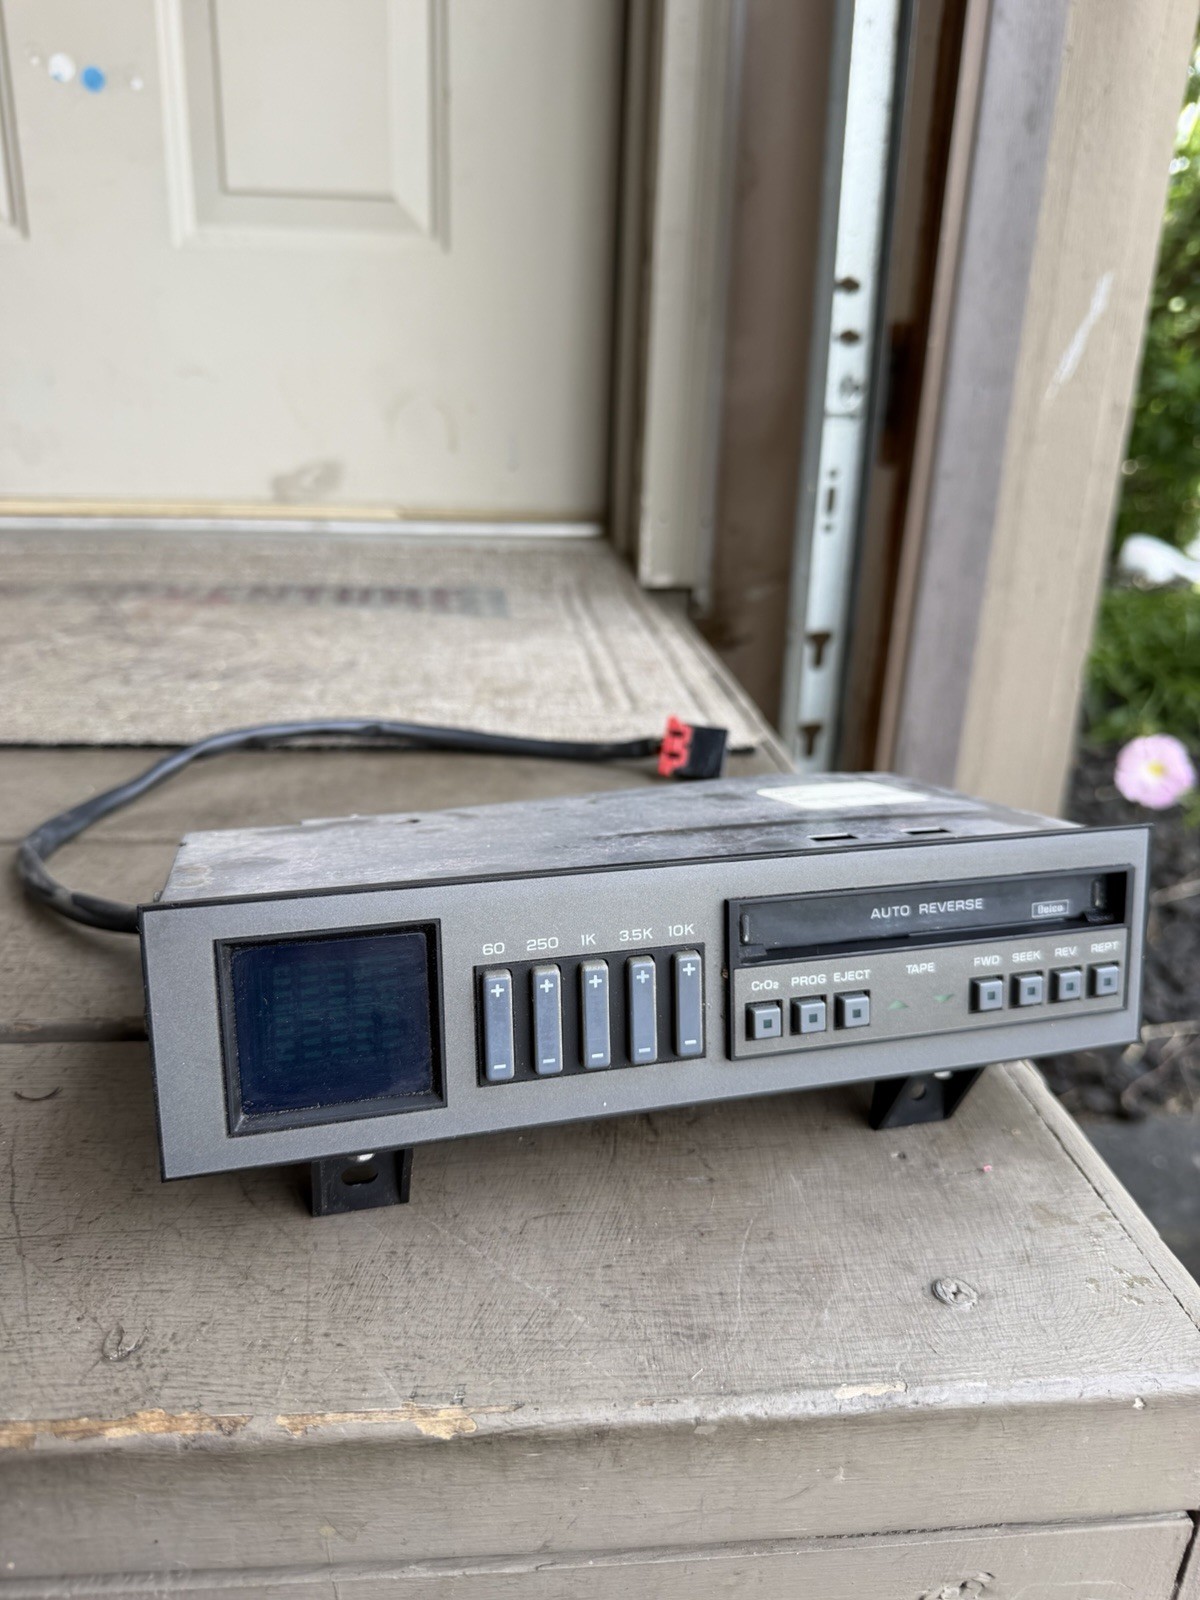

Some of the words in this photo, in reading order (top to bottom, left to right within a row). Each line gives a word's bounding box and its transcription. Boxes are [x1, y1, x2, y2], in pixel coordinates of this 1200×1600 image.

[870, 905, 911, 919] AUTO
[919, 898, 983, 914] REVERSE
[482, 942, 505, 956] 60
[526, 937, 559, 951] 250
[581, 933, 596, 946] 1K
[619, 927, 653, 942] 3.5K
[668, 923, 695, 937] 10K
[973, 955, 1001, 967] FWD
[1011, 950, 1042, 963] SEEK
[1054, 945, 1078, 958] REV
[1090, 940, 1119, 953] REPT
[791, 974, 827, 987] PROG
[833, 969, 871, 982] EJECT
[906, 962, 936, 975] TAPE
